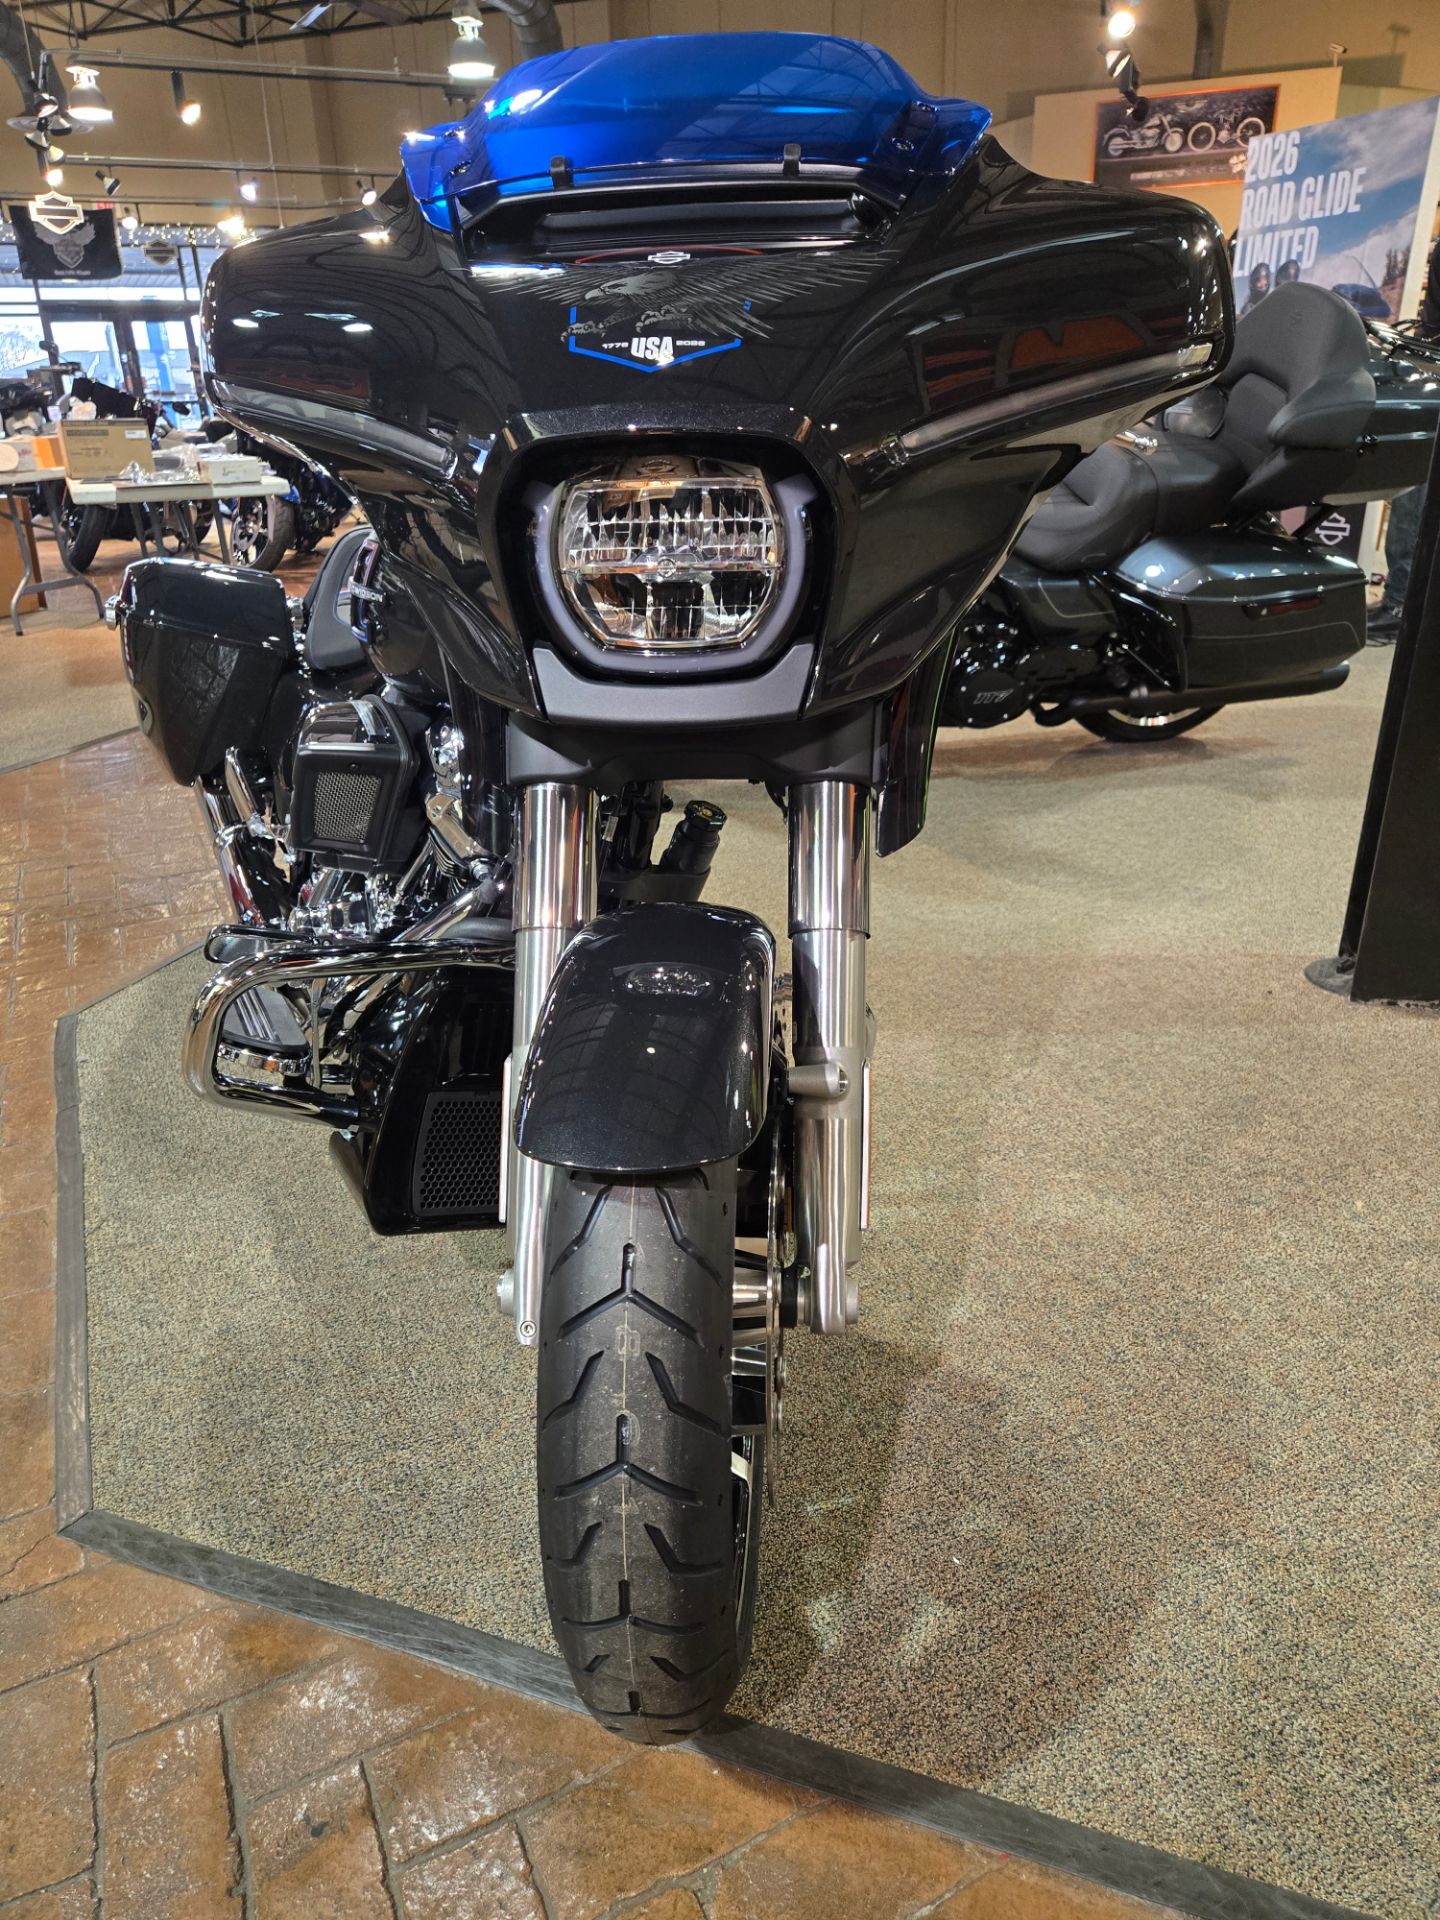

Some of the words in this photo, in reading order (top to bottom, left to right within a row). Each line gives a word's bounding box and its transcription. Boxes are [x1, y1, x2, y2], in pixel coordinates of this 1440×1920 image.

[1244, 131, 1300, 184] 2026
[1240, 182, 1297, 230] ROAD
[1298, 167, 1367, 221] GLIDE
[1233, 226, 1320, 277] LIMITED
[631, 336, 674, 361] USA
